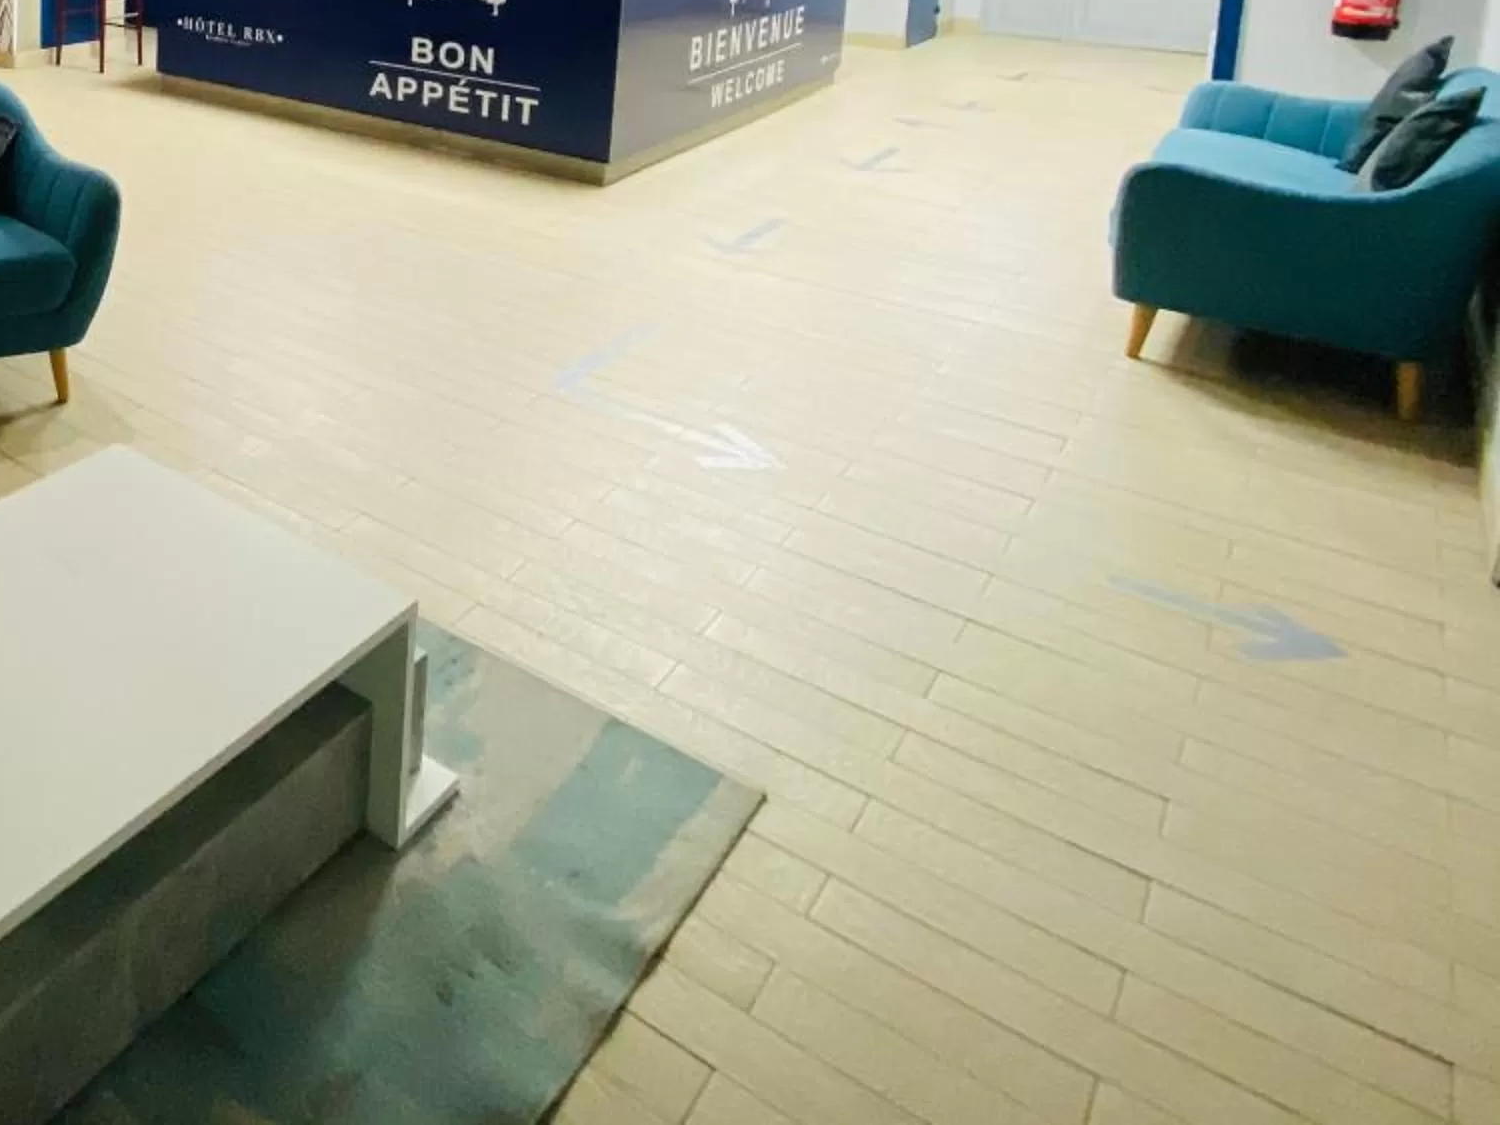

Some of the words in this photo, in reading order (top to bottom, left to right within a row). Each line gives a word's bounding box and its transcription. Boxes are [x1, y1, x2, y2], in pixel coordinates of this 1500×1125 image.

[243, 26, 276, 44] RBX
[411, 36, 495, 75] BON
[690, 5, 806, 72] BIENVENUE
[368, 72, 540, 126] APPÉTIT
[711, 59, 786, 108] WELCOME
